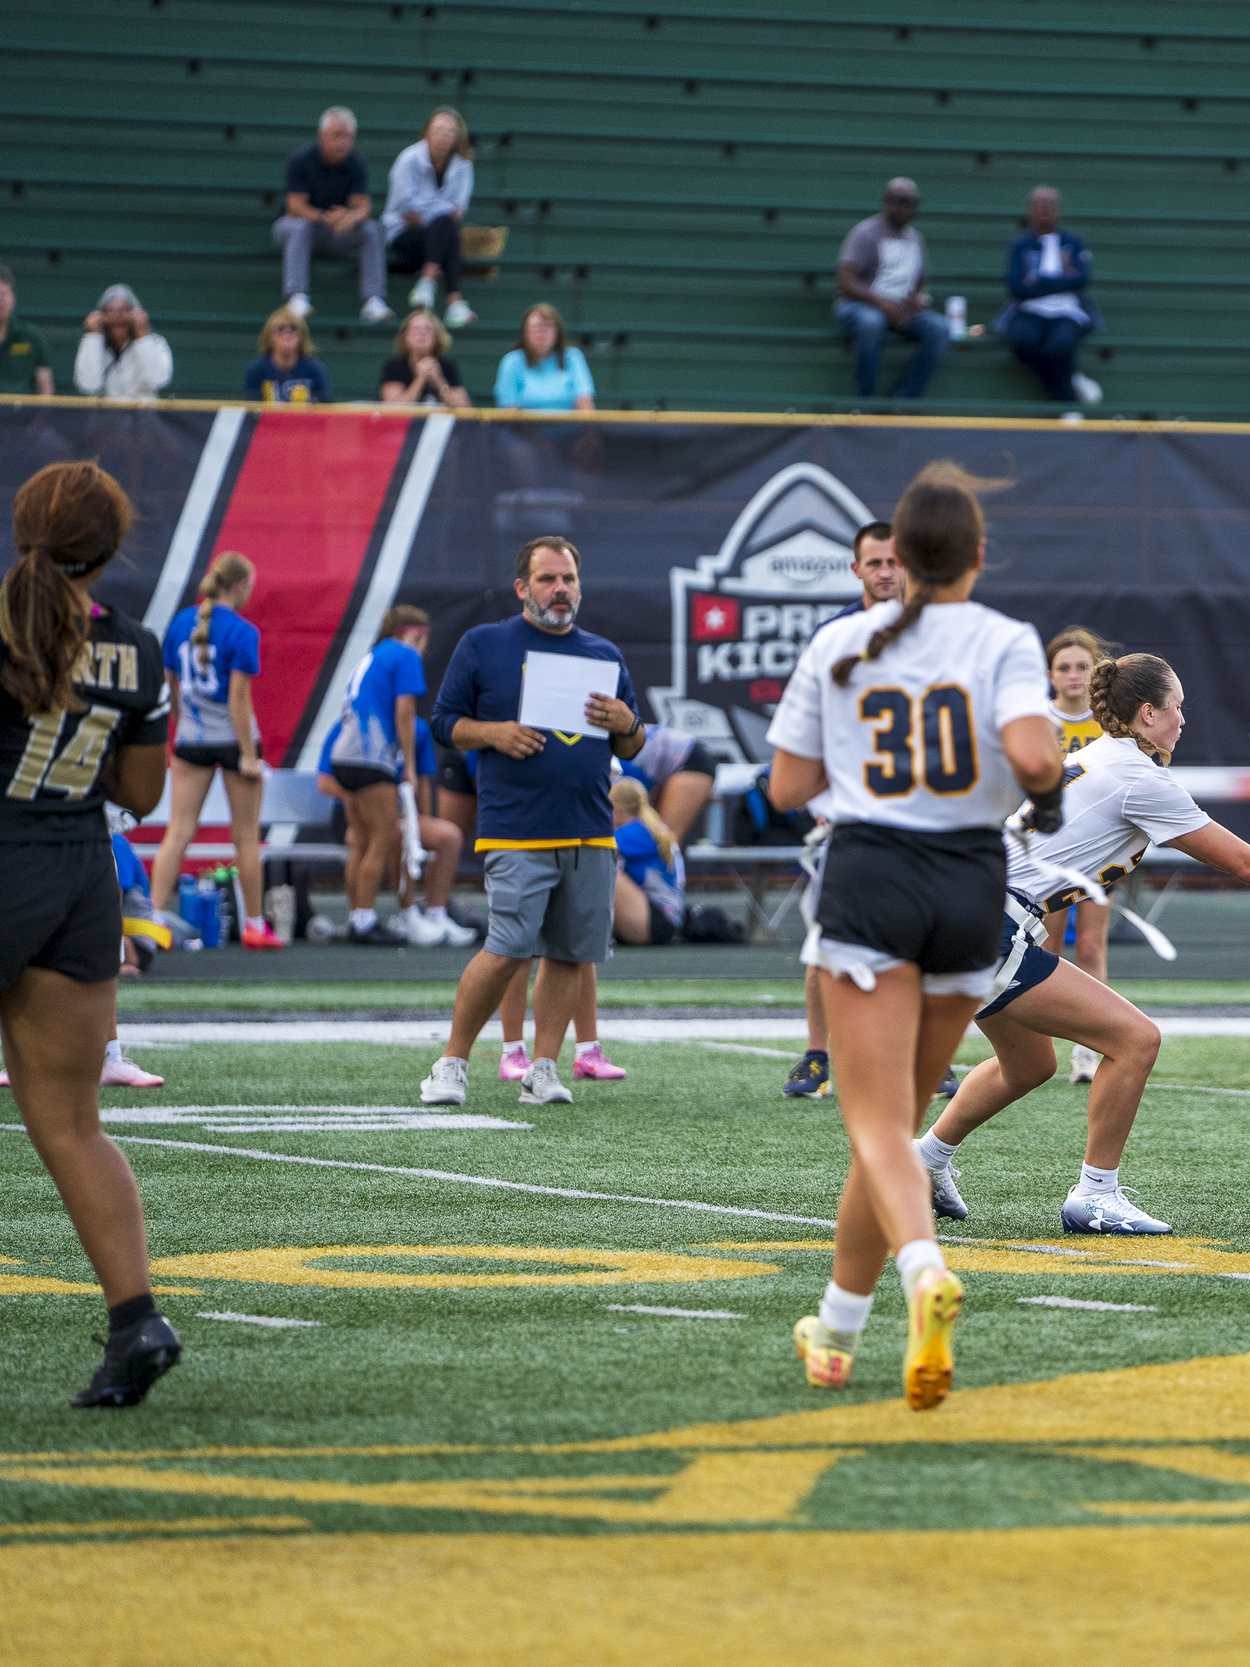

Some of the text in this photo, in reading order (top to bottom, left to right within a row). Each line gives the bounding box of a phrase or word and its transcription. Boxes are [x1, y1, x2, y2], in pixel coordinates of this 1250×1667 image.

[72, 641, 139, 693] RTH
[697, 638, 809, 684] KIC
[6, 704, 122, 801] 14
[856, 684, 979, 800] 30
